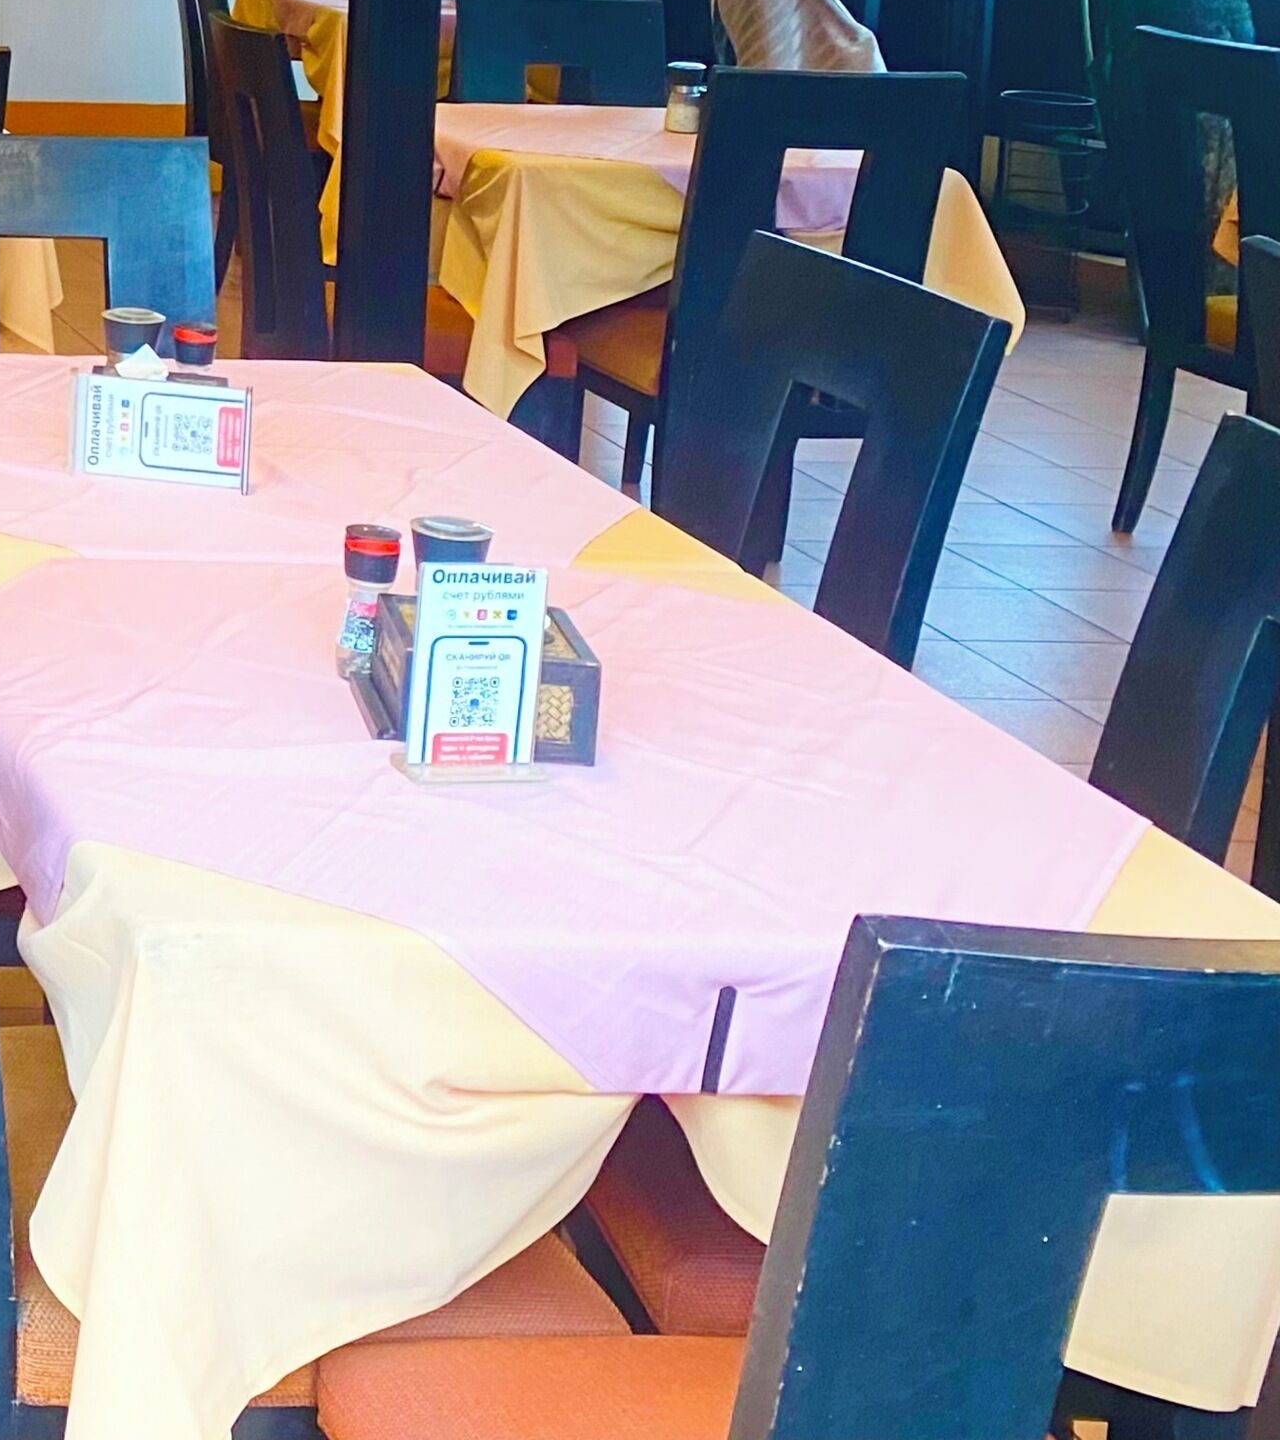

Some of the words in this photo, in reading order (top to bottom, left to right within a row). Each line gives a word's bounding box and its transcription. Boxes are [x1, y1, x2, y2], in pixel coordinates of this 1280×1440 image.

[87, 385, 102, 466] Оплачивай
[432, 568, 536, 585] Оплачивай
[442, 591, 469, 600] счет
[473, 590, 524, 602] рублями
